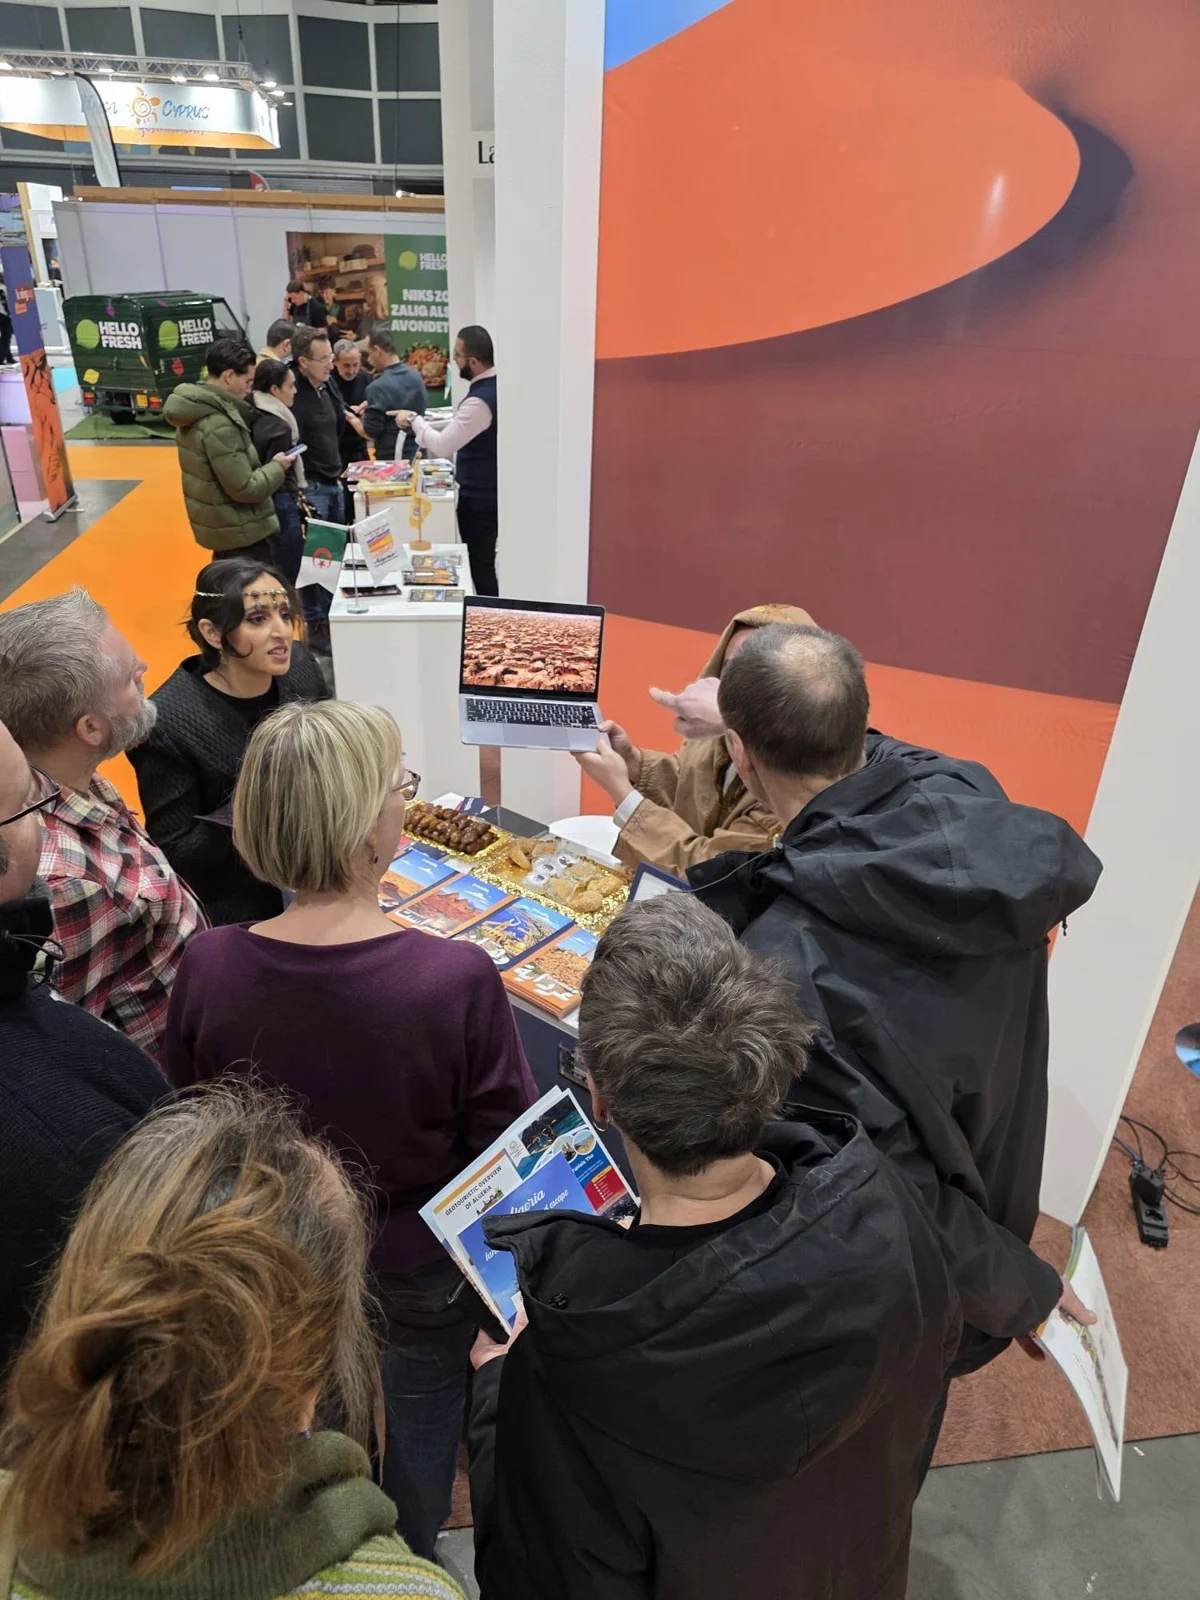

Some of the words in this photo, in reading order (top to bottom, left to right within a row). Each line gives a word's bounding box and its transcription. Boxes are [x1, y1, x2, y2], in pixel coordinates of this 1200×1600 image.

[162, 100, 210, 120] CYPRUS
[419, 252, 447, 262] HELLO
[402, 289, 434, 302] NIKS
[391, 303, 428, 317] ZALIG
[98, 321, 139, 337] HELLO
[178, 318, 212, 334] HELLO
[101, 336, 142, 350] FRESH
[180, 331, 214, 347] FRESH
[445, 1185, 479, 1216] GEOTOURISTIC
[479, 1165, 502, 1188] OVERVIEW
[472, 1185, 492, 1204] ALGERIA
